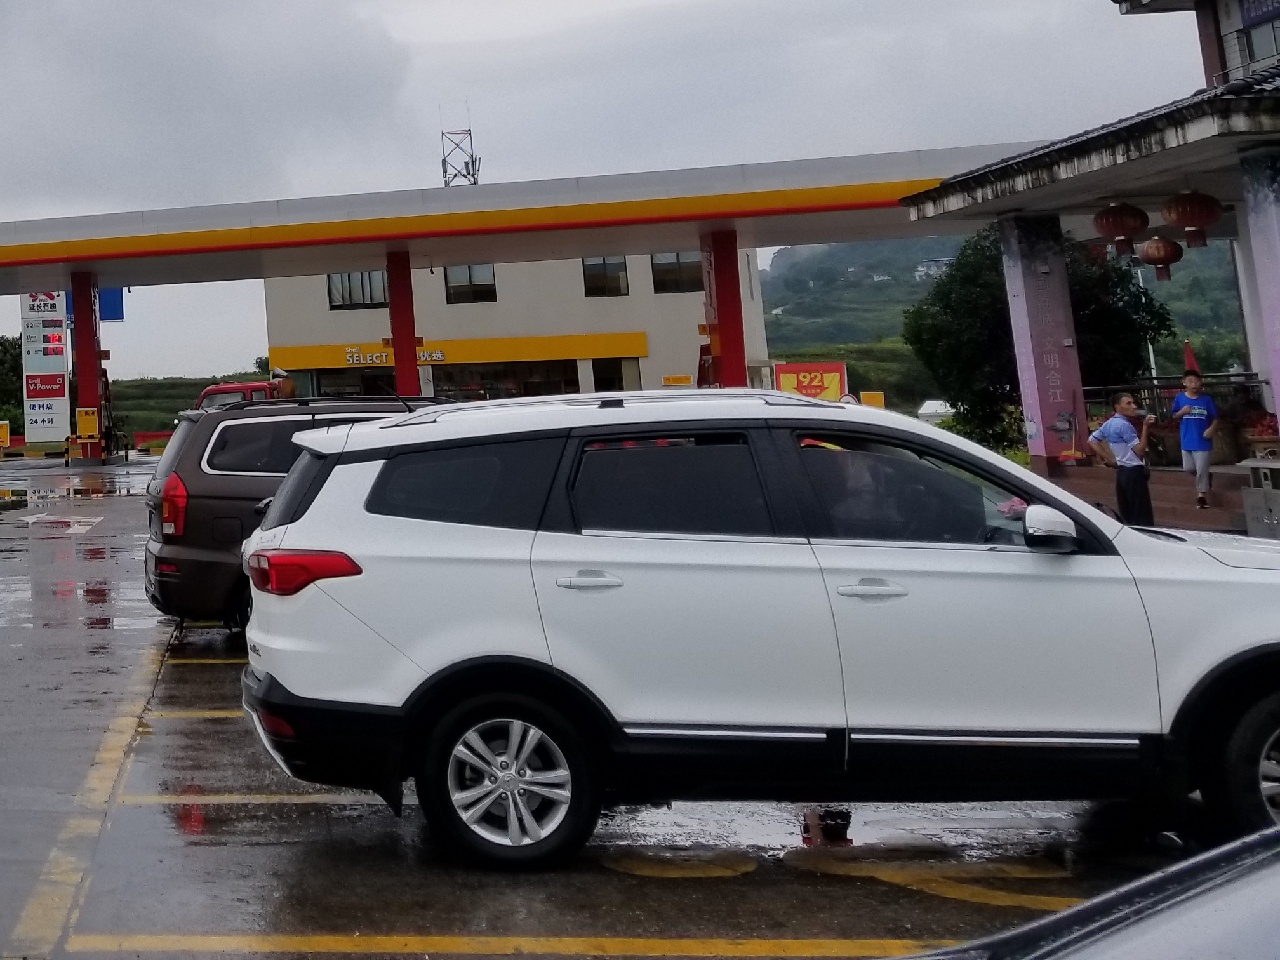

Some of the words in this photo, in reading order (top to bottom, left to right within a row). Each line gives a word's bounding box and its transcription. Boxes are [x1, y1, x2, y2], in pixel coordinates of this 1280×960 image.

[346, 353, 388, 364] SELECT
[799, 372, 822, 386] 92
[28, 383, 61, 391] V-Power
